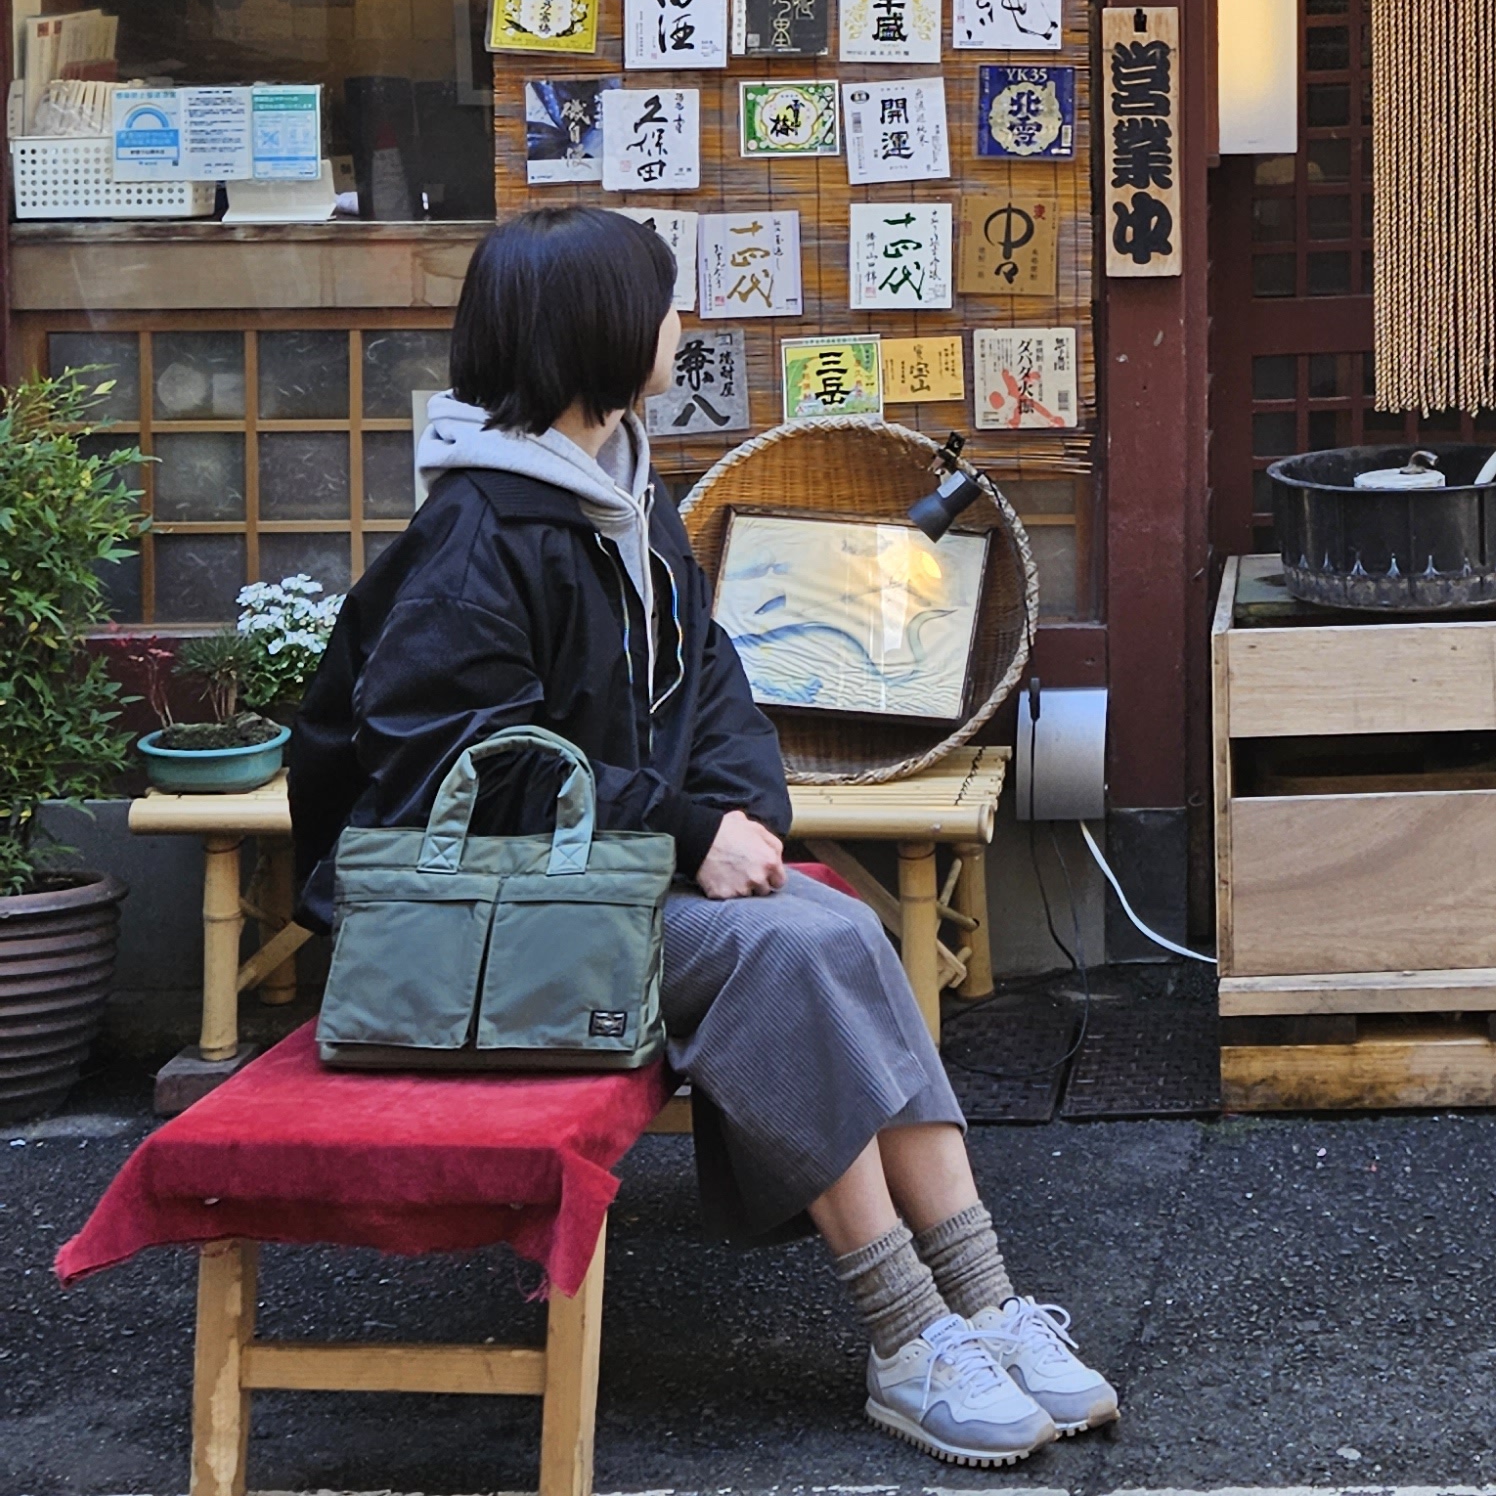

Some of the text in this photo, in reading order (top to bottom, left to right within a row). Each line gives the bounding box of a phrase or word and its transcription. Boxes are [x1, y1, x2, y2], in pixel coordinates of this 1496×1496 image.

[1006, 68, 1048, 83] YK35
[1007, 89, 1043, 147] 北雪
[626, 94, 669, 183] 久保田
[880, 97, 915, 161] 開運
[1112, 40, 1174, 264] 営業中
[726, 220, 775, 308] 十四代
[878, 212, 925, 301] 十四代
[671, 339, 731, 427] 兼八
[815, 351, 851, 406] 三岳
